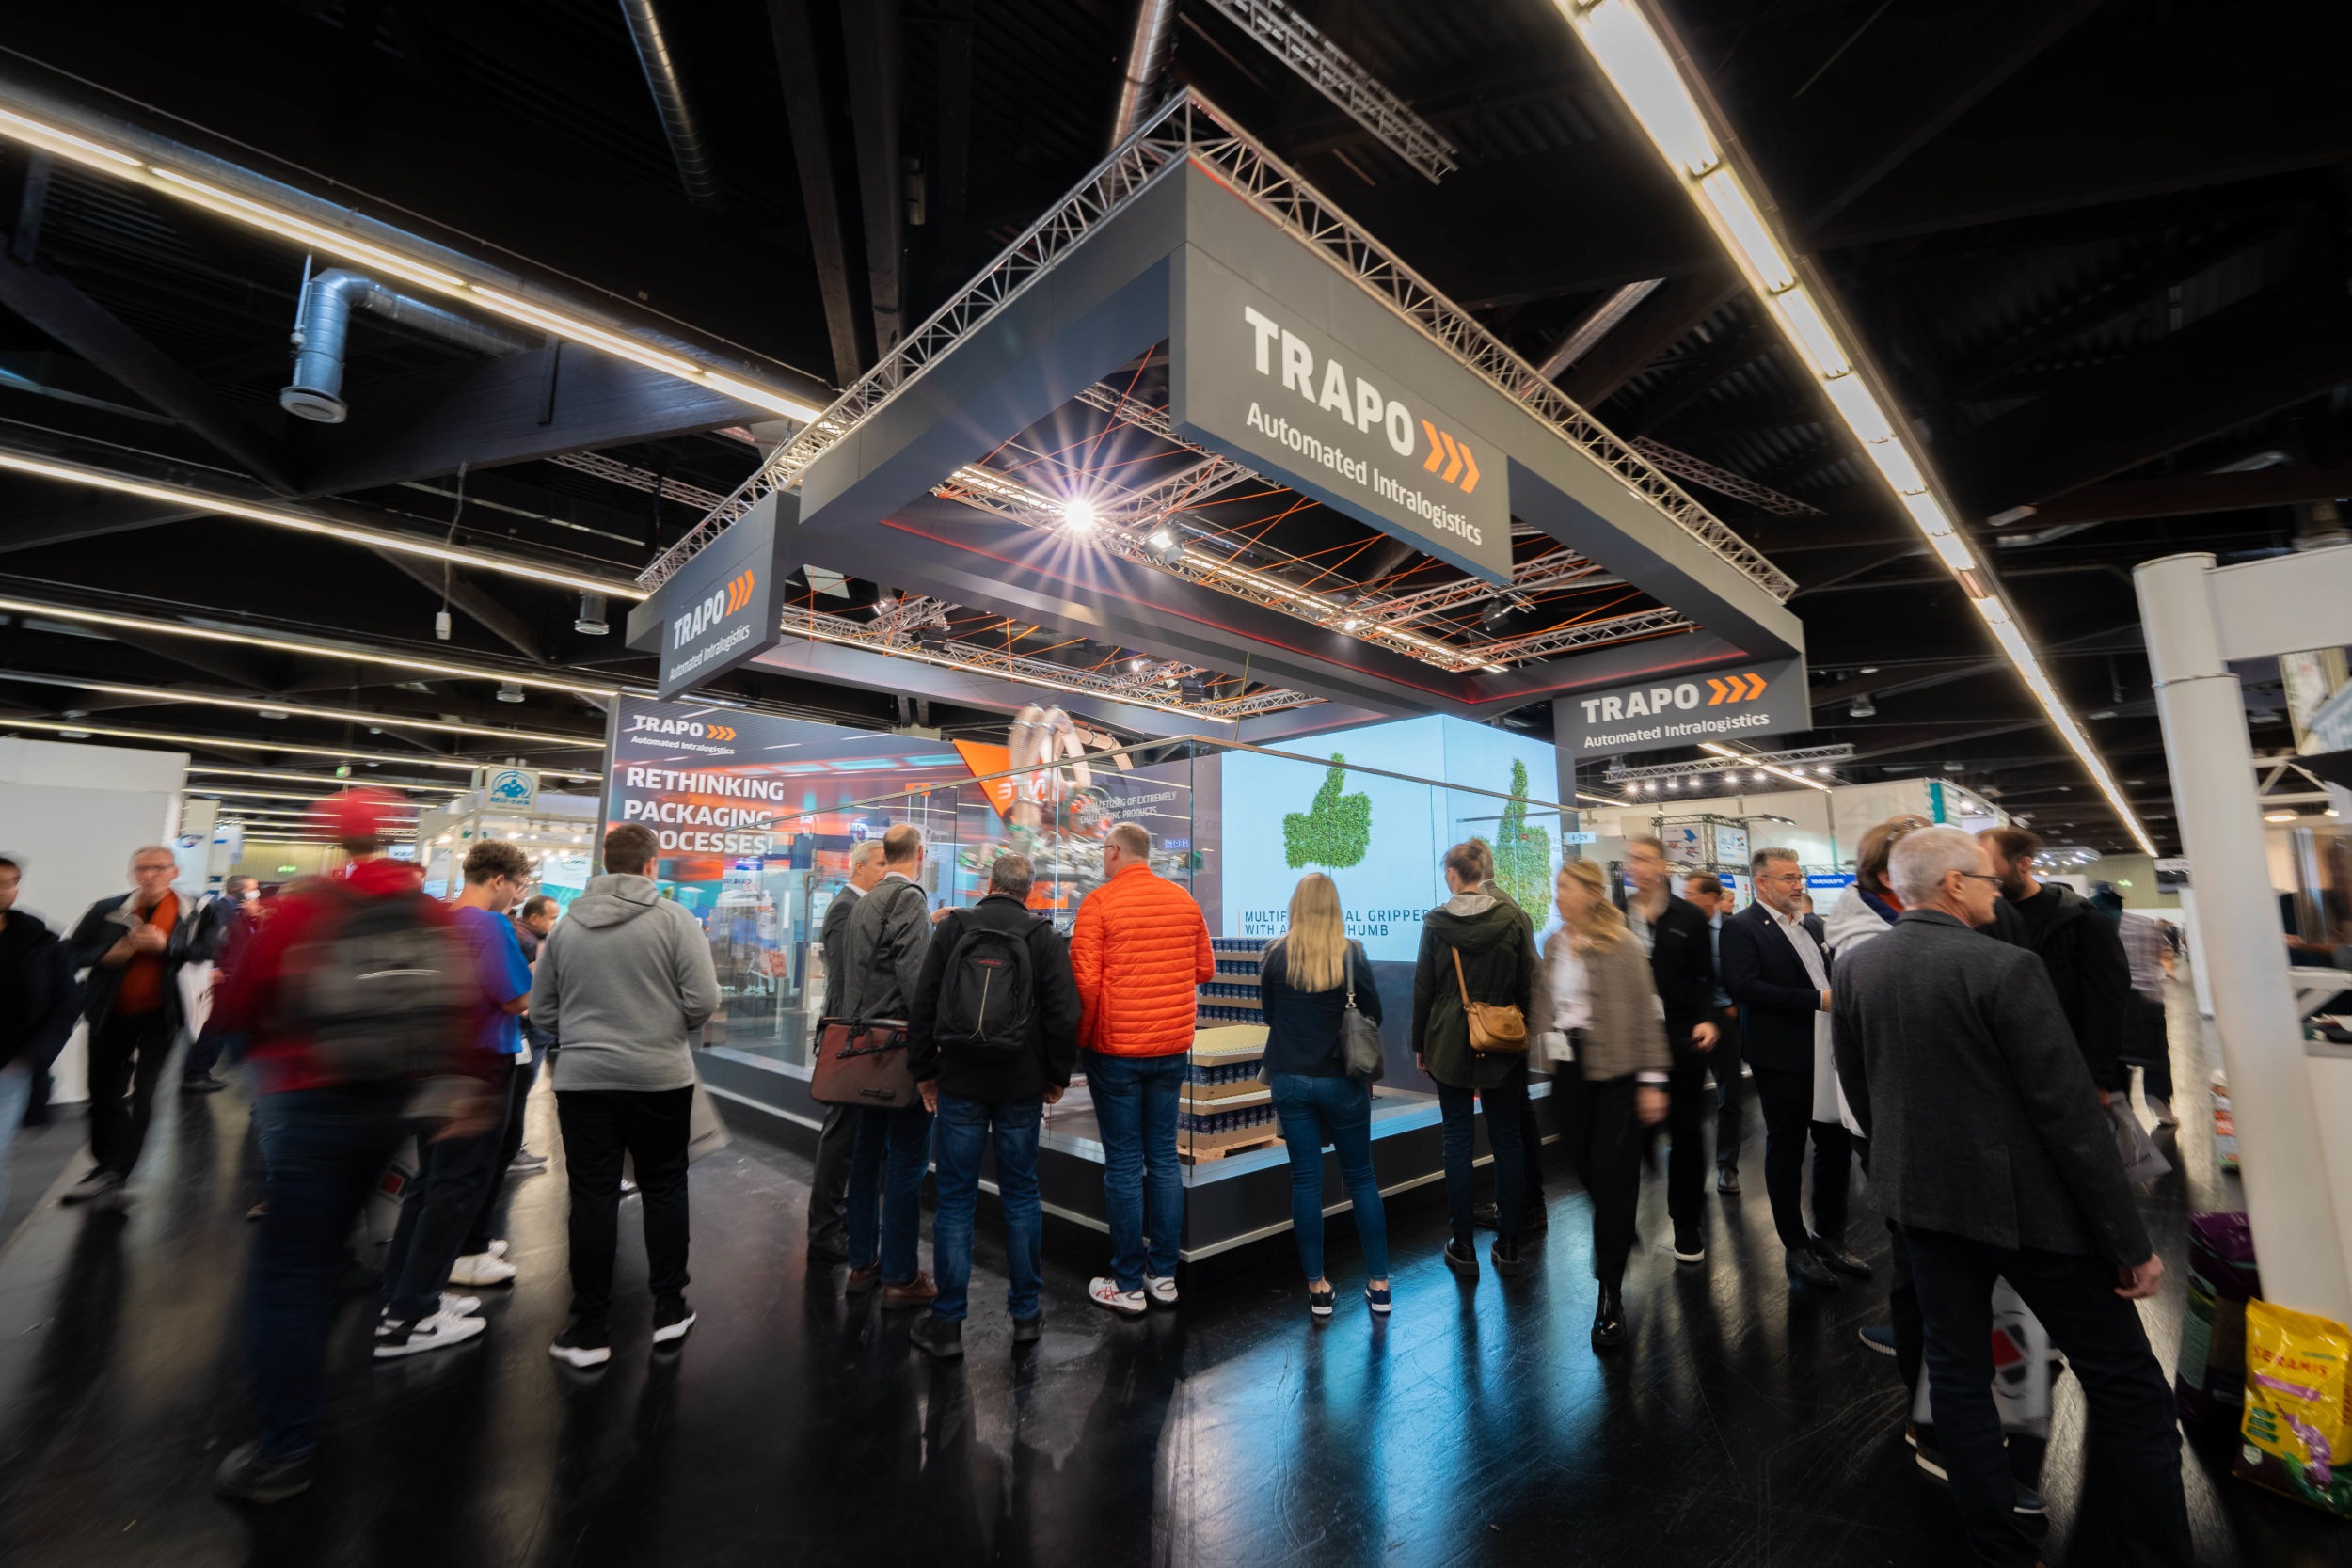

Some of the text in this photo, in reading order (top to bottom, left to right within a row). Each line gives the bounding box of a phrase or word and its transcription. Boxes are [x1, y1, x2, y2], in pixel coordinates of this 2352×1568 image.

[1245, 305, 1415, 457] TRAPO
[1246, 402, 1482, 546] Automated Intralogistics
[674, 589, 725, 650] TRAPO
[668, 624, 751, 683] Automated Intralogistics
[1581, 683, 1699, 724] TRAPO
[633, 715, 704, 737] TRAPO
[1584, 713, 1770, 748] Automated Intralogistics
[631, 736, 736, 755] Automated Intralogistics
[627, 767, 784, 800] RETHINKING
[1127, 797, 1136, 806] OF
[1137, 791, 1177, 805] EXTREMELY
[623, 799, 771, 830] PACKAGING
[1122, 806, 1157, 819] PRODUCTS
[649, 828, 773, 855] OCESSES!
[1245, 924, 1275, 935] WITH
[1343, 924, 1389, 937] HUMB
